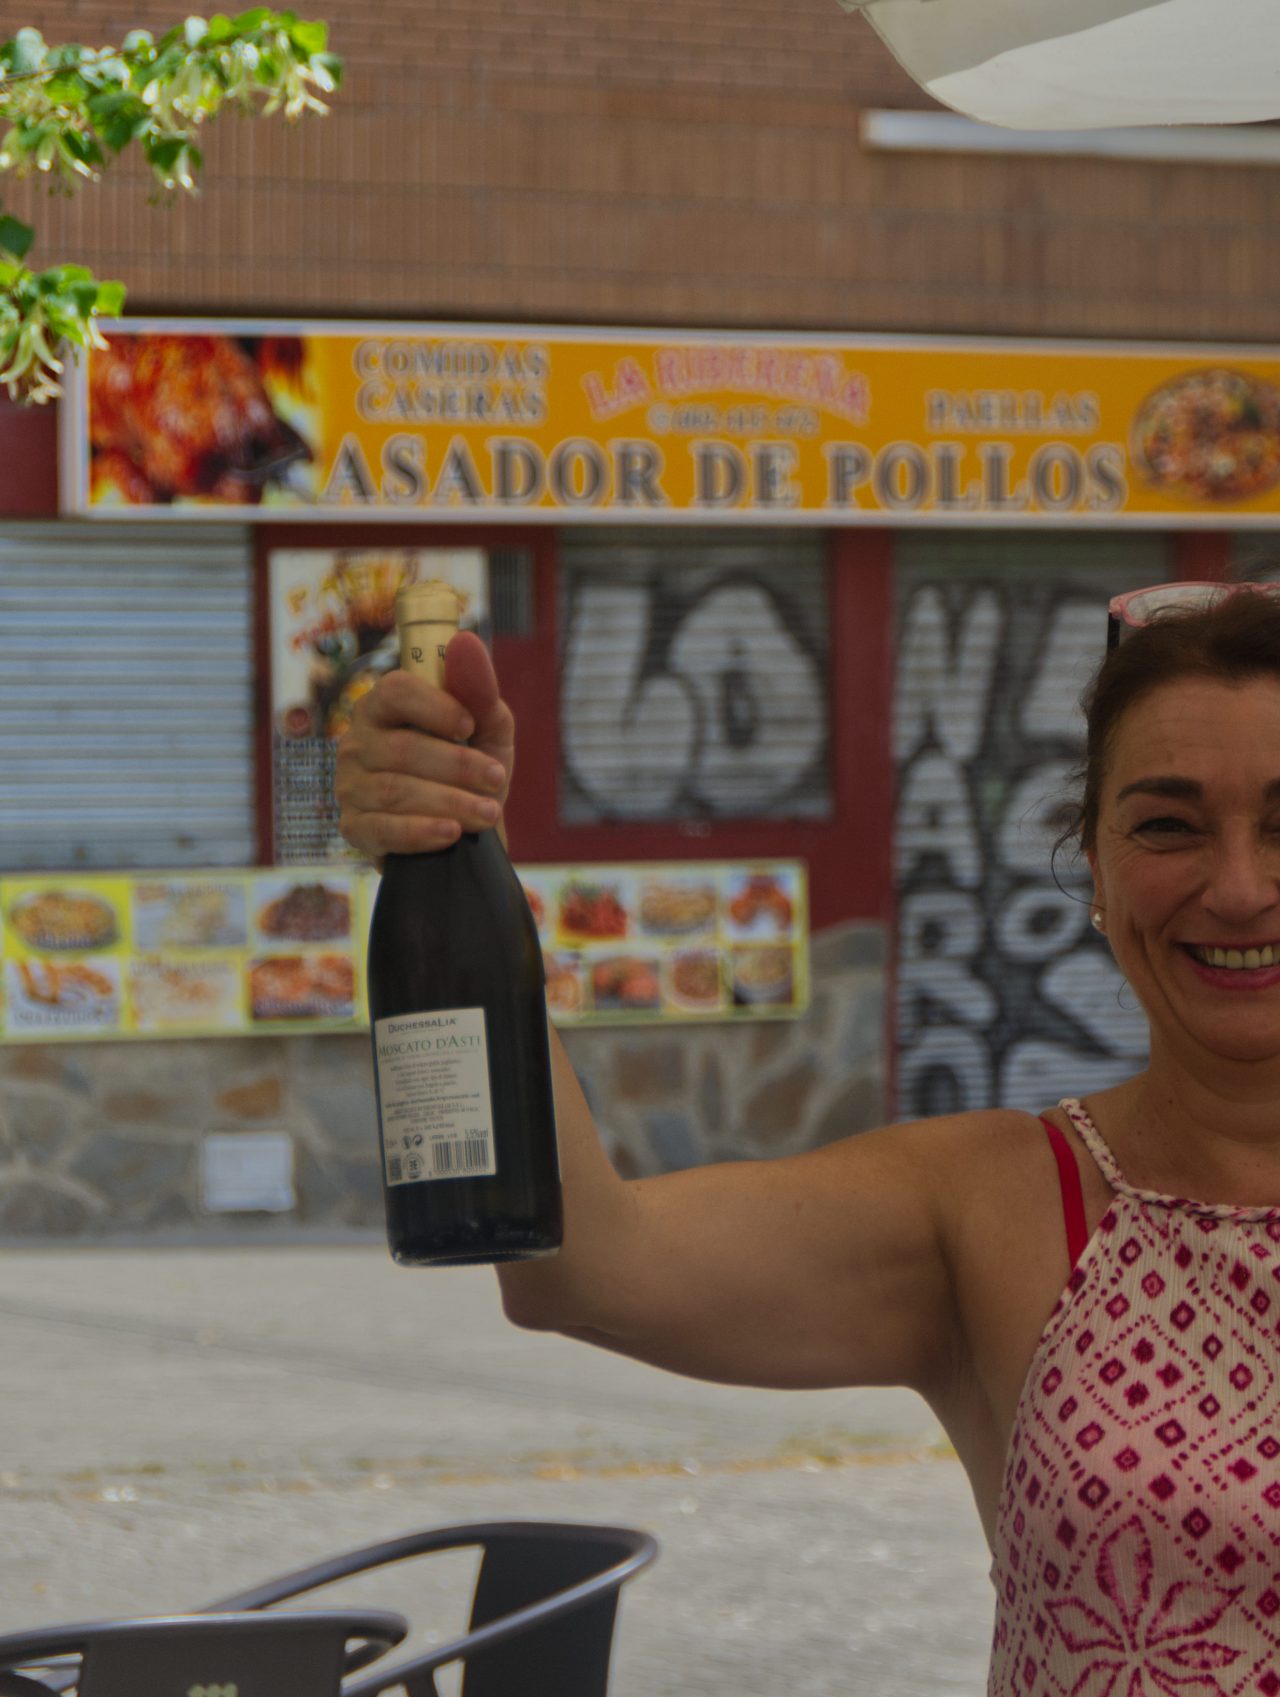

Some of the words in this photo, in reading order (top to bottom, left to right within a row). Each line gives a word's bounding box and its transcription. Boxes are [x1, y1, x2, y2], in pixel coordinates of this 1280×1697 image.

[354, 341, 549, 380] COMIDAS
[358, 382, 546, 424] CASERAS
[584, 359, 652, 419] LA
[928, 391, 1099, 431] PAELLAS
[326, 436, 665, 506] ASADOR
[693, 439, 798, 506] DE
[825, 443, 1125, 510] POLLOS
